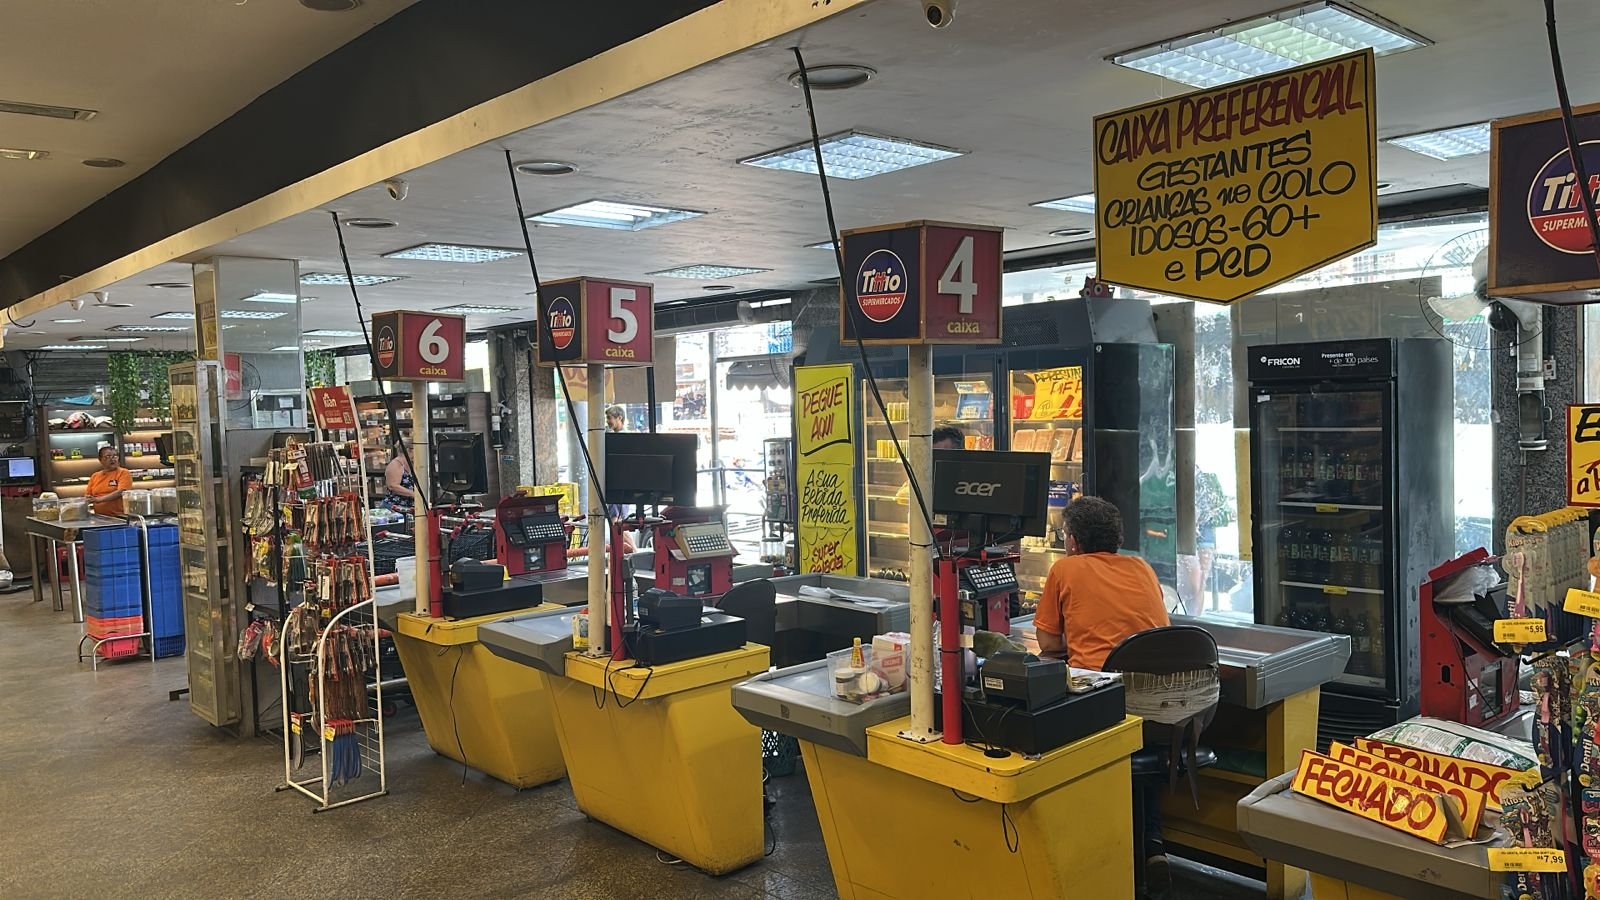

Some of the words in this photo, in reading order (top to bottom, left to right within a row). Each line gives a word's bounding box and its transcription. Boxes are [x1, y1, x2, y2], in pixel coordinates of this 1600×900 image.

[1099, 107, 1171, 165] CAIXA
[1177, 60, 1363, 149] PREFERENCIAL
[1137, 130, 1312, 191] GESTANTES
[1258, 160, 1357, 203] COLO
[938, 236, 978, 314] 4
[1165, 260, 1185, 281] e
[862, 297, 901, 307] SUPERMERCADOS
[608, 287, 638, 344] 5
[947, 318, 980, 333] caixa
[419, 319, 450, 364] 6
[605, 346, 635, 358] caixa
[420, 366, 447, 375] caixa
[1268, 357, 1300, 366] FRICON
[801, 382, 844, 418] PEGUE
[811, 412, 835, 442] AQUI
[806, 469, 815, 487] A
[955, 481, 1001, 496] acer
[802, 486, 847, 507] Bebida
[802, 504, 850, 527] Preferida
[1530, 626, 1544, 634] 5,99
[1580, 739, 1593, 772] Dentil
[1301, 757, 1437, 831] FECHADO
[1543, 855, 1564, 864] 7,99
